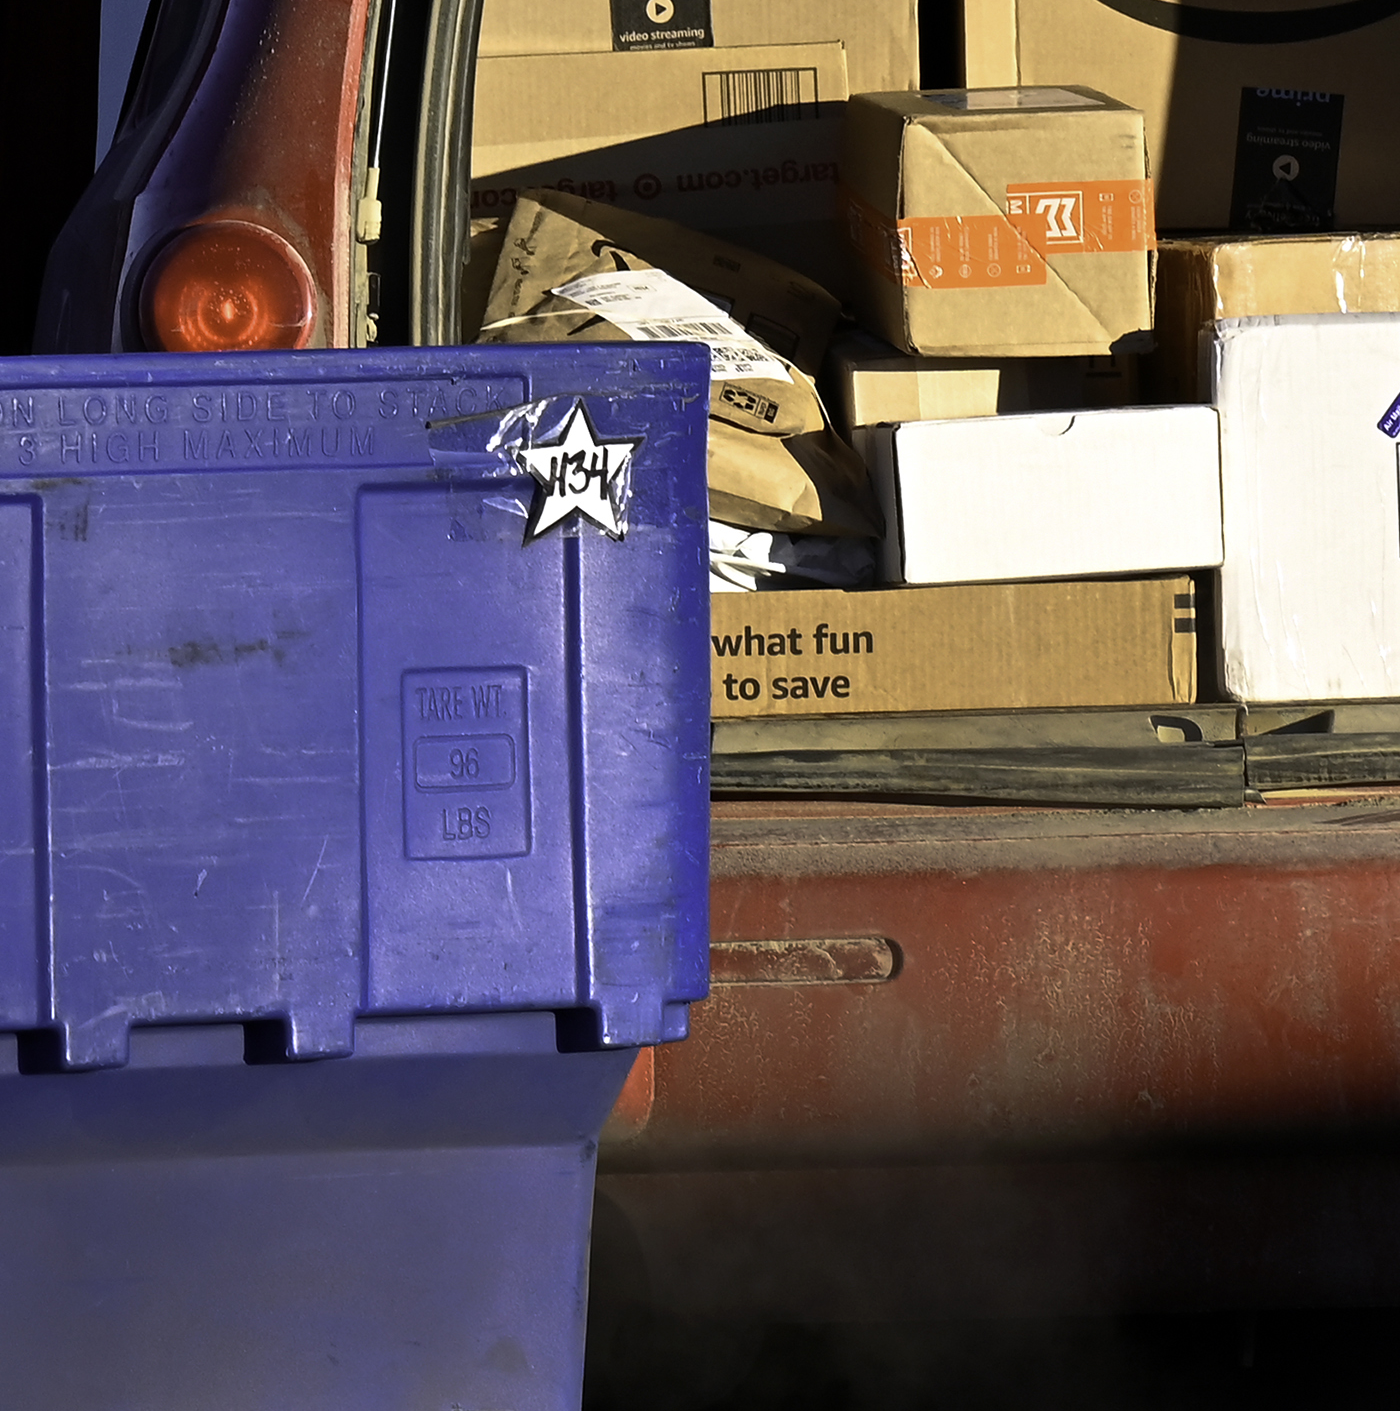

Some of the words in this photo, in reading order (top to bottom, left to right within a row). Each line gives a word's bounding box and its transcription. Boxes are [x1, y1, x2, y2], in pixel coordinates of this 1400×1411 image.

[619, 30, 649, 43] video
[650, 26, 705, 41] streaming
[1246, 132, 1300, 148] streaming
[1302, 140, 1331, 152] video
[677, 159, 840, 194] target.com
[57, 391, 168, 425] LONG
[192, 391, 286, 424] SIDE
[307, 389, 356, 419] TO
[377, 385, 505, 420] STACK
[1382, 416, 1395, 432] Air
[17, 436, 37, 467] 3
[59, 431, 160, 464] HIGH
[182, 426, 376, 461] MAXIMUM
[545, 446, 610, 501] H34
[711, 625, 802, 658] what
[812, 623, 874, 655] fun
[415, 686, 464, 721] TARE
[471, 684, 508, 719] WT.
[722, 672, 760, 702] to
[771, 675, 850, 701] save
[449, 747, 480, 780] 96
[442, 806, 491, 841] LBS
